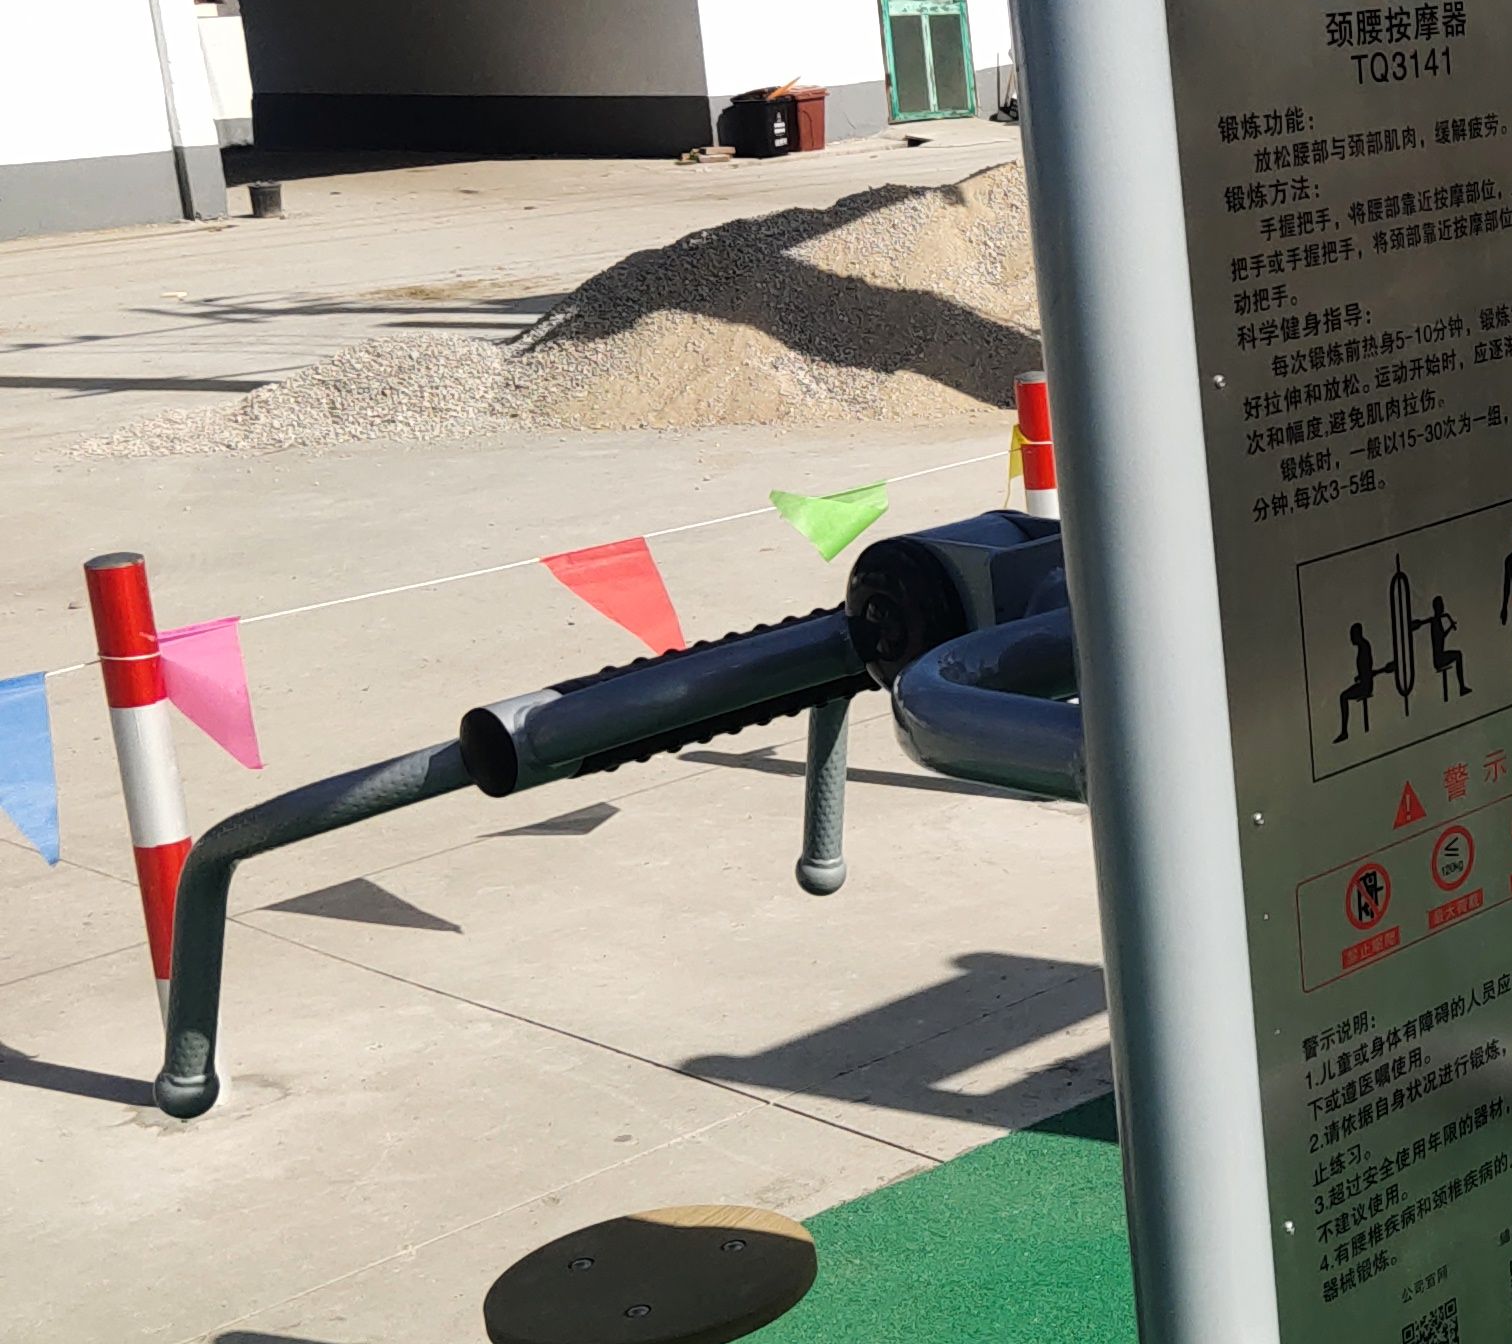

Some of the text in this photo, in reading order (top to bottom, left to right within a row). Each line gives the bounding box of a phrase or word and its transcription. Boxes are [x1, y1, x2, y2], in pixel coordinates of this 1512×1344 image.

[1325, 1, 1467, 49] 颈腰按摩器
[1351, 46, 1452, 85] TQ3141
[1218, 106, 1316, 145] 锻炼功能：
[1223, 174, 1321, 214] 锻炼方法：
[1232, 283, 1299, 317] 动把手。
[1236, 301, 1372, 352] 科学健身指导：
[1311, 1143, 1372, 1188] 止练习。
[1316, 1183, 1409, 1245] 不建议使用。
